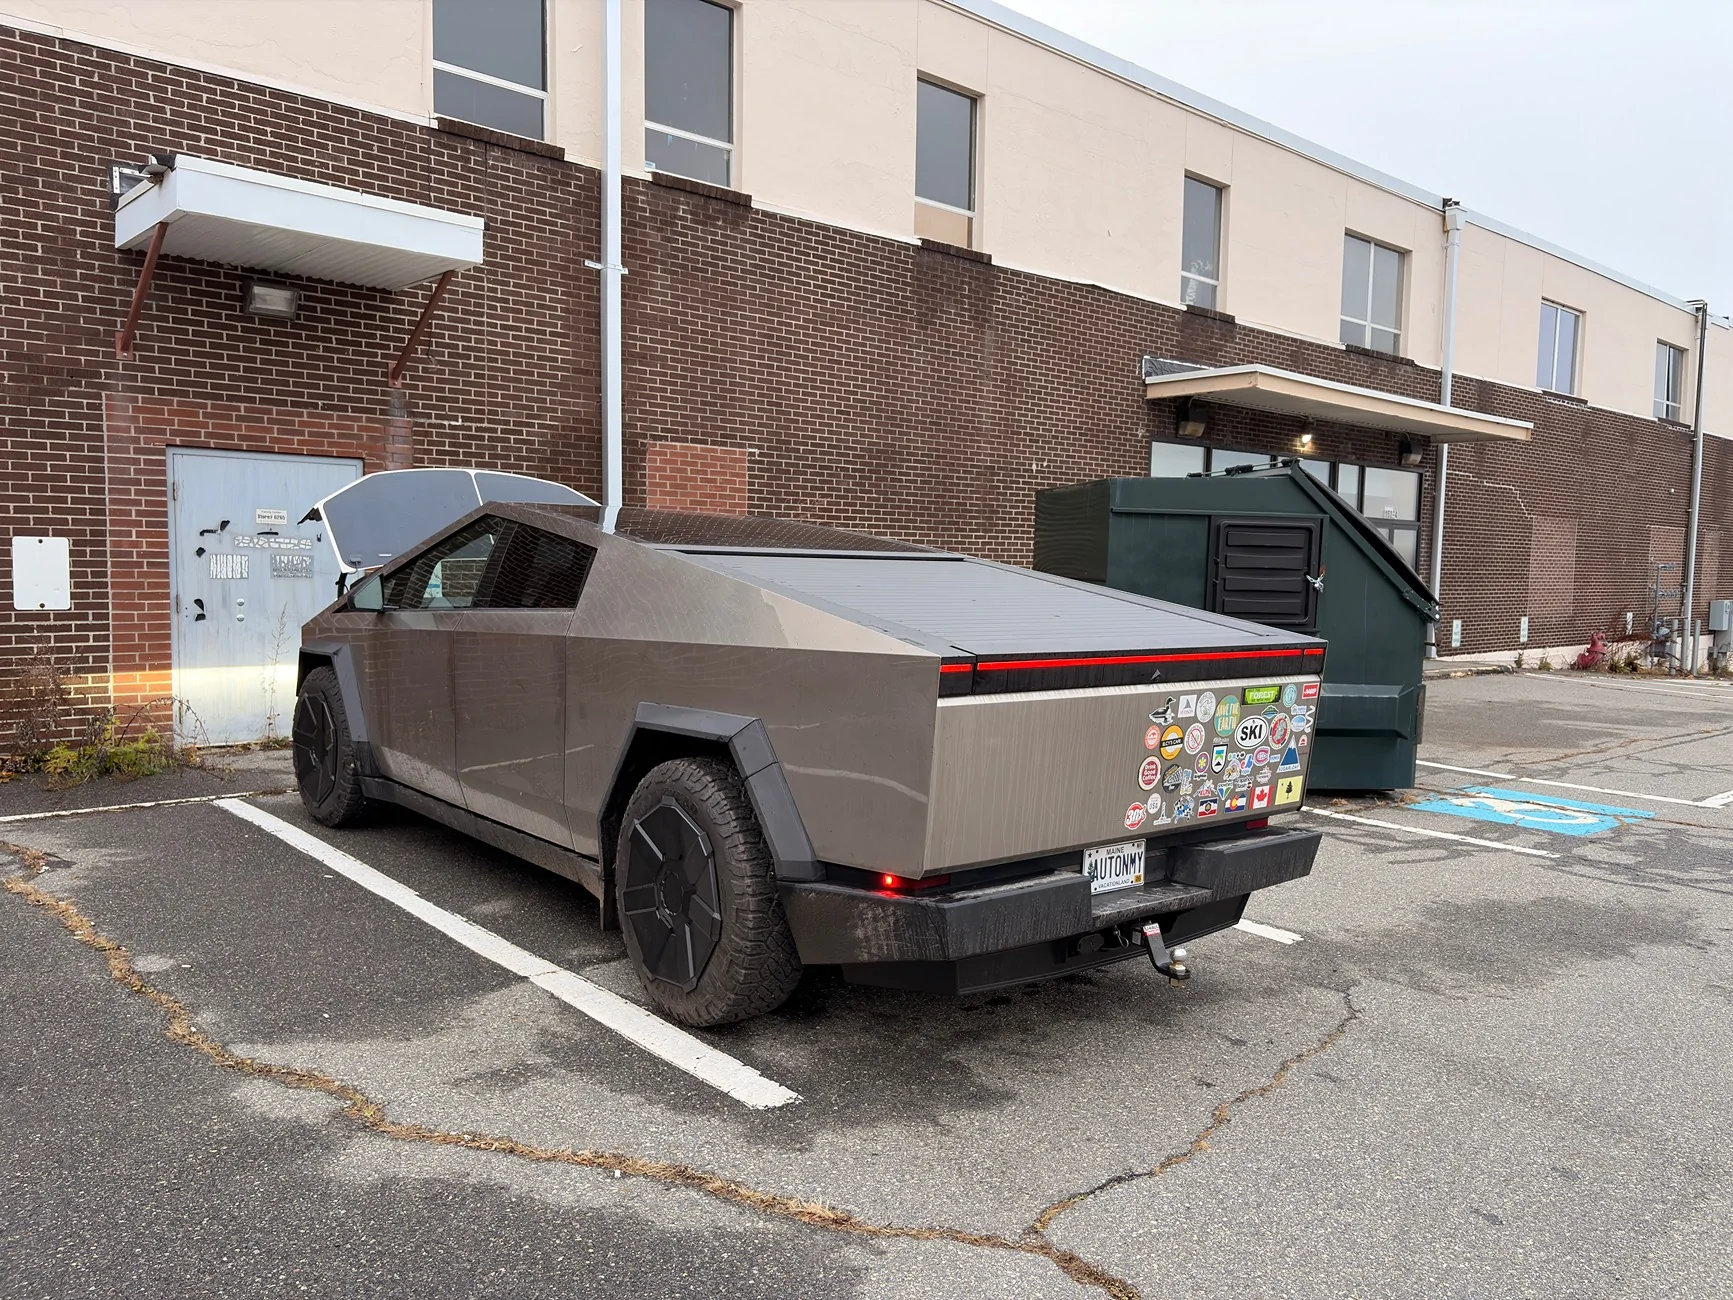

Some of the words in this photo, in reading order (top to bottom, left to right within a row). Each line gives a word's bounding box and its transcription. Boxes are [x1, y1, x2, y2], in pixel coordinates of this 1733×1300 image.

[1250, 691, 1274, 699] FOREST
[1216, 703, 1229, 717] SAVE
[1229, 702, 1240, 715] THE
[1217, 716, 1237, 731] EARTH
[1240, 724, 1263, 741] SKI
[1106, 846, 1125, 855] MAINE
[1093, 851, 1143, 881] AUTONMY
[1097, 879, 1130, 889] VACATIONLAND
